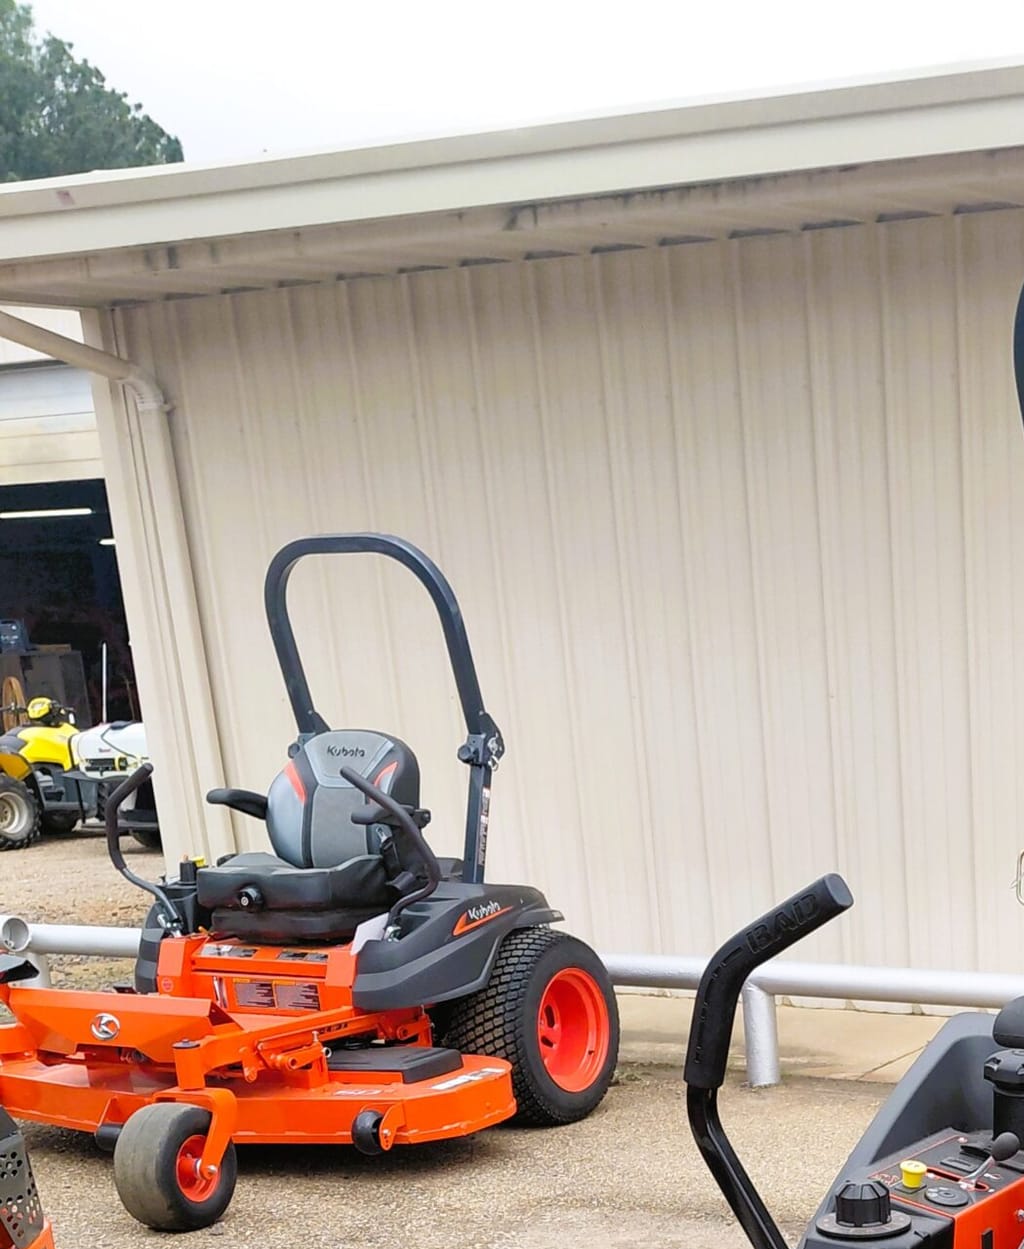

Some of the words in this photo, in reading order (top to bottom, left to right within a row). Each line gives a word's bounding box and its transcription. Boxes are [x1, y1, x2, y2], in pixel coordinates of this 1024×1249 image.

[327, 745, 366, 757] Kubota
[467, 900, 501, 920] Kubota
[746, 893, 820, 953] BAD
